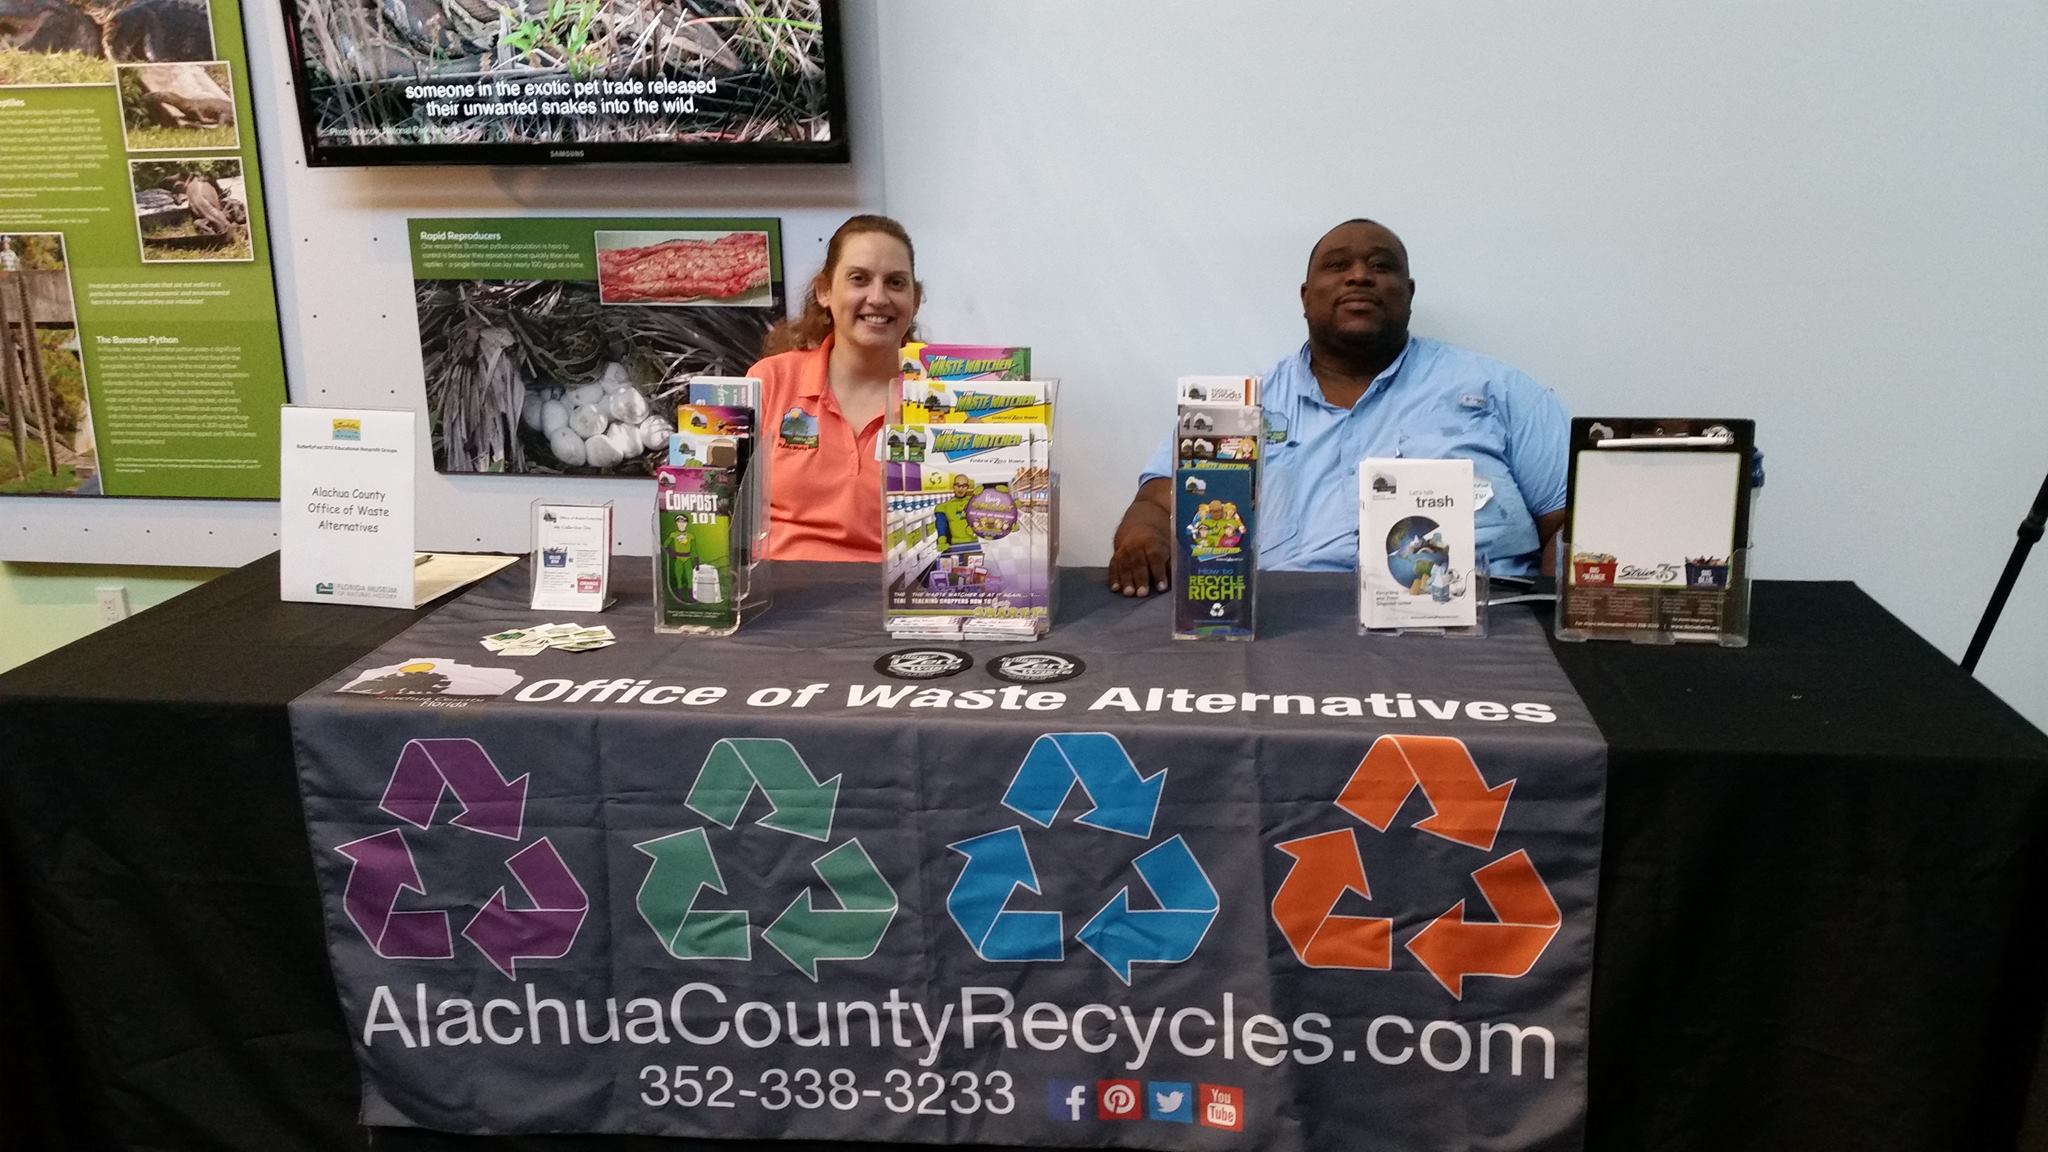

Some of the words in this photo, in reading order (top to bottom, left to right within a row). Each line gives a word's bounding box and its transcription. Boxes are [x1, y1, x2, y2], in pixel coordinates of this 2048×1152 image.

[405, 82, 474, 99] someone
[477, 81, 491, 96] in
[494, 80, 522, 96] the
[524, 79, 570, 96] exotic
[574, 79, 600, 98] pet
[603, 79, 643, 95] trade
[648, 77, 717, 94] released
[426, 100, 459, 117] their
[464, 99, 538, 116] unwanted
[541, 97, 597, 114] snakes
[601, 97, 630, 113] into
[634, 97, 659, 113] the
[662, 96, 698, 113] wild.
[550, 150, 585, 158] SAMSUNG
[420, 231, 446, 242] Rapid
[447, 231, 502, 242] Reproducers
[96, 335, 111, 344] The
[112, 335, 148, 344] Burmese
[149, 335, 179, 346] Python
[927, 359, 963, 377] WASTE
[964, 358, 1014, 374] WATCHER
[955, 395, 988, 412] WASTE
[988, 395, 1036, 410] WATCHER
[932, 434, 972, 453] WASTE
[971, 434, 1022, 449] WATCHER
[312, 487, 349, 499] Alachua
[352, 488, 386, 502] County
[665, 490, 718, 512] COMPOST
[1415, 494, 1454, 508] trash
[308, 503, 340, 515] Office
[342, 504, 354, 515] of
[357, 505, 390, 517] Waste
[318, 520, 379, 533] Alternatives
[691, 512, 717, 525] 101
[1189, 575, 1244, 586] RECYCLE
[1655, 563, 1681, 583] 75
[337, 583, 366, 592] FLORIDA
[367, 584, 398, 594] MUSEUM
[1188, 585, 1245, 601] RIGHT
[515, 678, 728, 706] Office
[746, 682, 829, 708] of
[845, 685, 1068, 711] Waste
[1088, 686, 1558, 724] Alternatives
[363, 982, 1557, 1080] AlachuaCountyRecycles.com
[638, 1064, 1016, 1116] 352-338-3233
[1211, 1089, 1231, 1104] You
[1208, 1105, 1234, 1123] Tube
